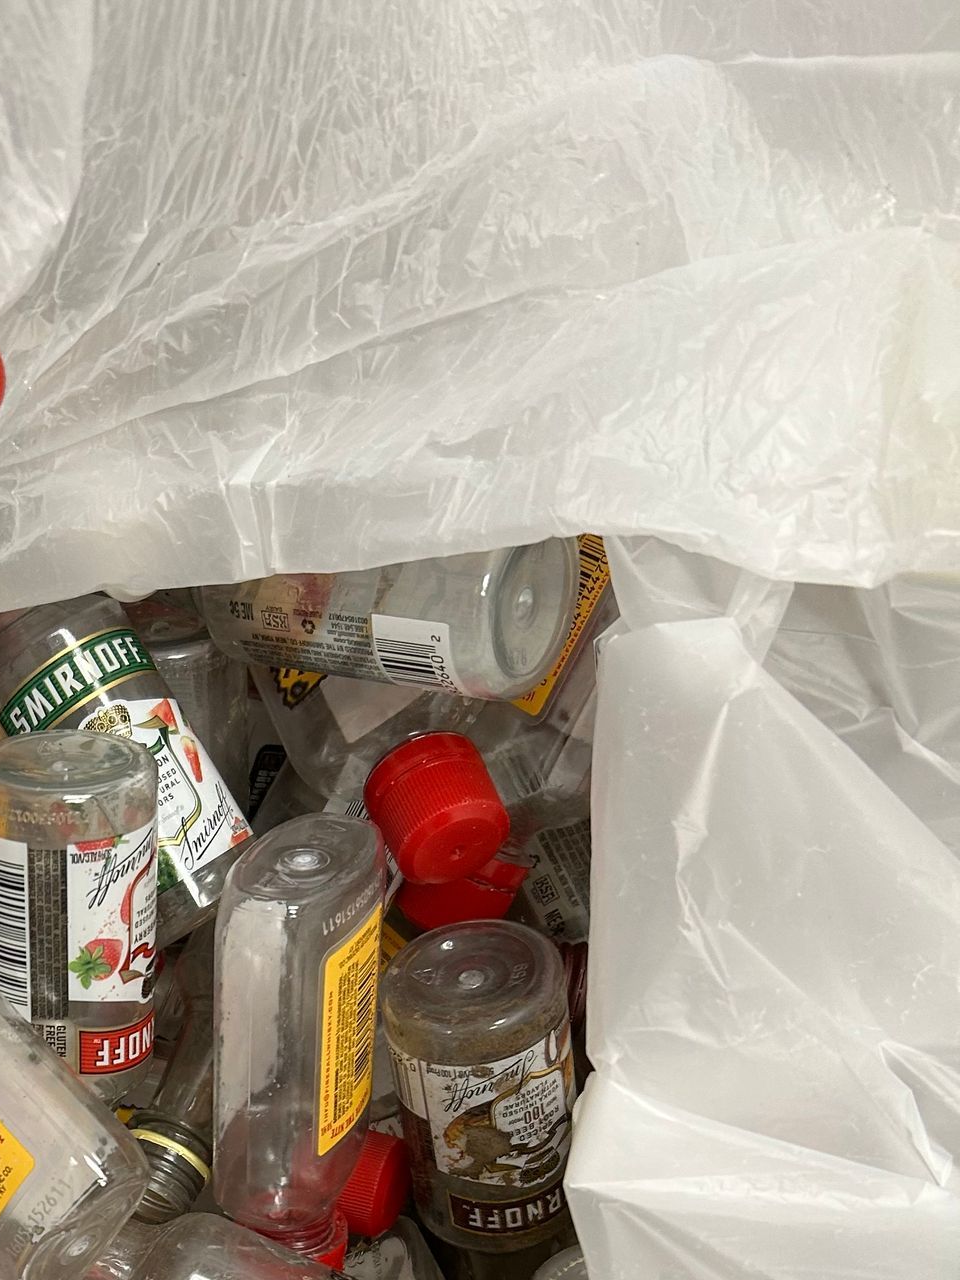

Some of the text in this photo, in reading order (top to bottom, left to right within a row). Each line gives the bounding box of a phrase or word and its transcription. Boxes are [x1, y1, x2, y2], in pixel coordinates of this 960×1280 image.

[430, 634, 440, 642] 2
[9, 634, 141, 735] SMIRNOFF
[181, 784, 232, 869] Smirnoff
[54, 1025, 67, 1057] GLUTEN
[95, 1021, 150, 1066] NOFF
[467, 1187, 562, 1231] RNOFF
